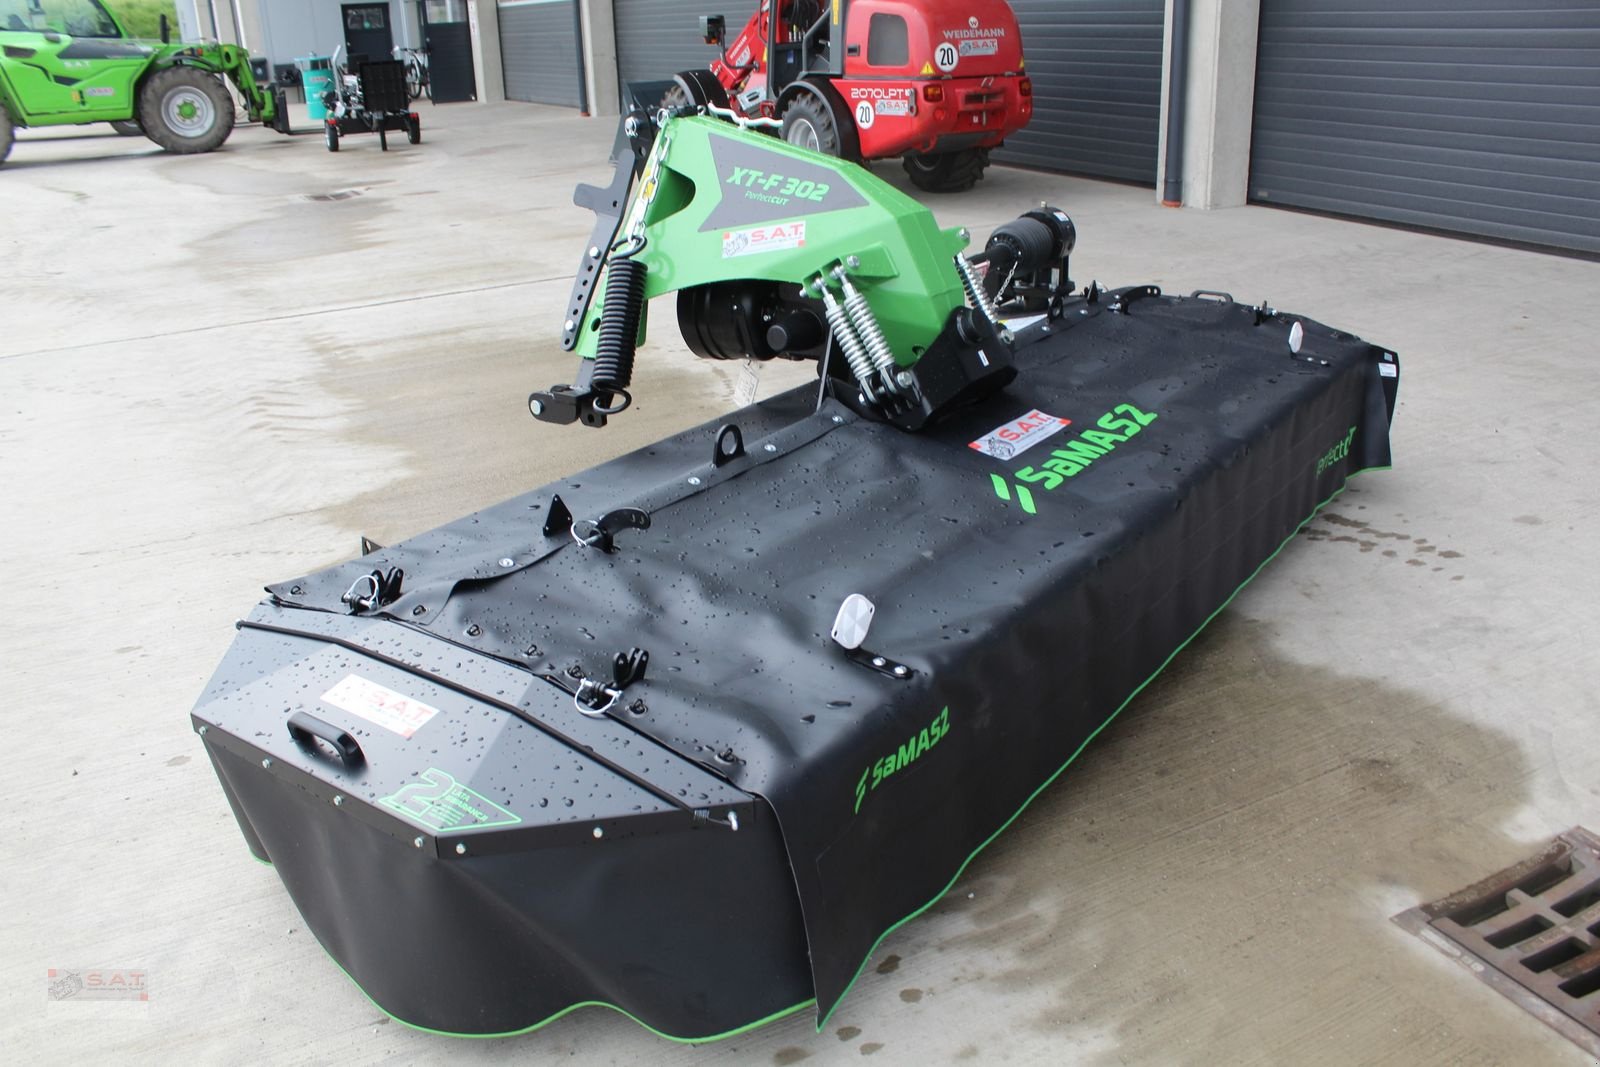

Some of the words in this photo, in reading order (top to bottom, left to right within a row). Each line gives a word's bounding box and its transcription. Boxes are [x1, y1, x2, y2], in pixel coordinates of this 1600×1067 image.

[942, 27, 1005, 39] WEIDEMANN
[940, 47, 954, 66] 20
[860, 105, 871, 124] 20
[726, 166, 784, 191] XT-F
[780, 177, 830, 202] 302
